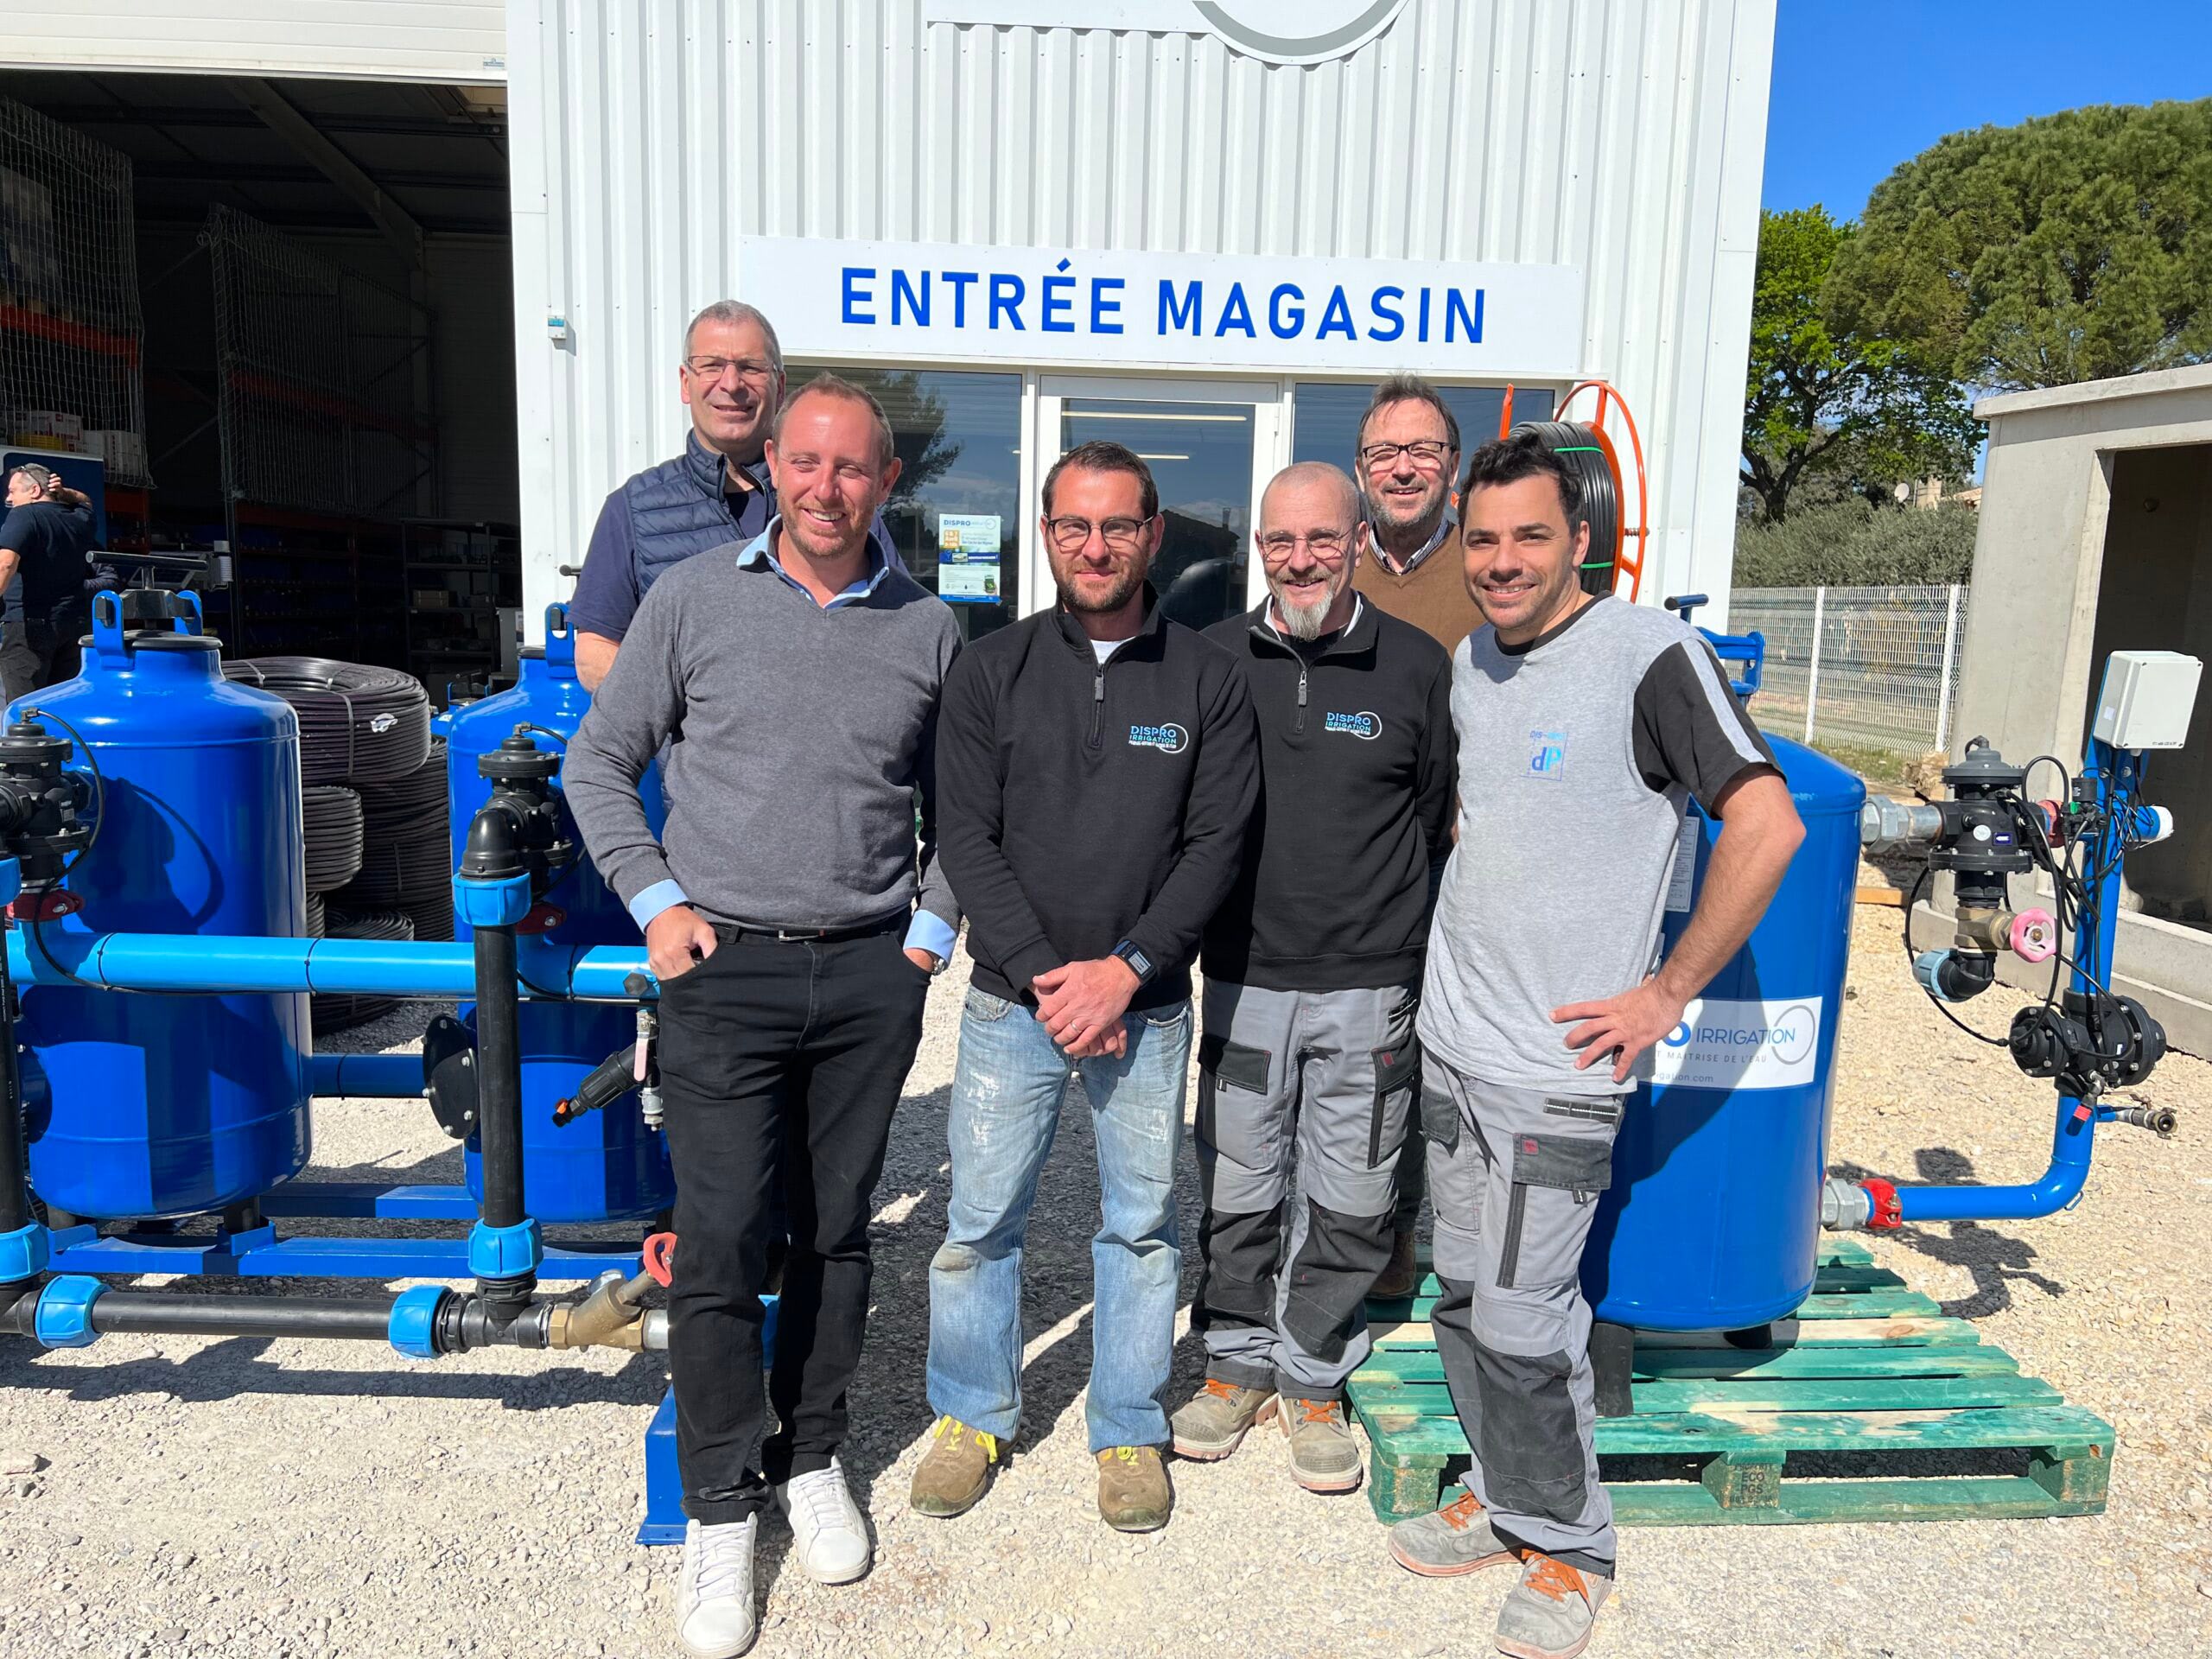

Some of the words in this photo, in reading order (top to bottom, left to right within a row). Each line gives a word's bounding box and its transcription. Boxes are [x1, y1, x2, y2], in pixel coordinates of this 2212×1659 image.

[842, 257, 1125, 334] ENTRÉE
[1157, 278, 1485, 344] MAGASIN
[1327, 712, 1371, 726] DISPRO
[1130, 725, 1177, 738] DISPRO
[1325, 721, 1371, 732] IRRIGATION
[1129, 734, 1177, 744] IRRIGATION
[1695, 1027, 1796, 1046] IRRIGATION
[1724, 1054, 1737, 1064] DE
[1741, 1054, 1767, 1064] L'EAU
[1741, 1471, 1764, 1483] ECO
